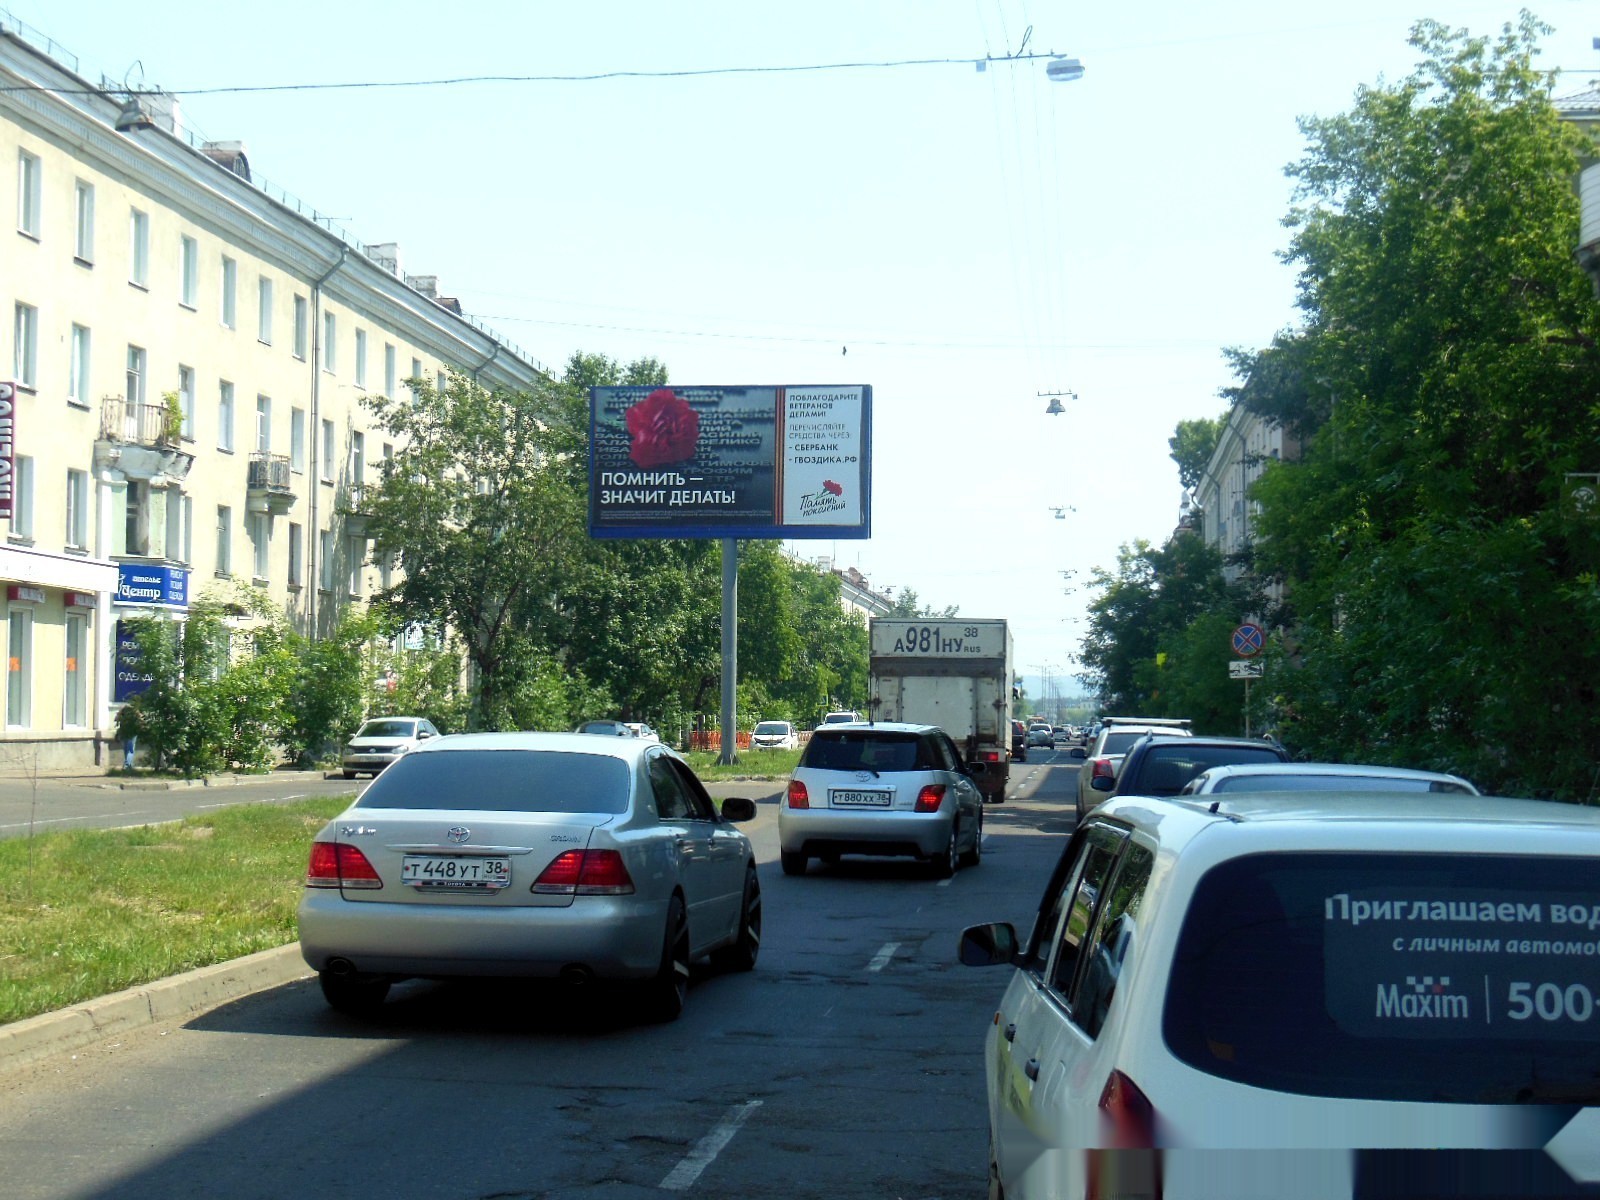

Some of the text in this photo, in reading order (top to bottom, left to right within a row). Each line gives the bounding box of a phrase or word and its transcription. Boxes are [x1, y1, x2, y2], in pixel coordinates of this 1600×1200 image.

[789, 423, 846, 431] ПЕРЕЧИСЛЯЙТЕ
[794, 456, 857, 464] ГВОЗДИКА.РФ
[601, 472, 686, 487] ПОМНИТЬ
[601, 490, 736, 507] ЗНАЧИТ ДЕЛАТЬ!
[800, 494, 837, 510] Память
[802, 501, 846, 518] поколений
[122, 584, 160, 600] Центр
[894, 626, 978, 653] А981НУ 38
[411, 860, 503, 878] Т448УТ 38
[1325, 894, 1541, 925] Приглашаем
[1392, 936, 1600, 956] с личным автомо
[1376, 983, 1468, 1018] Maxim
